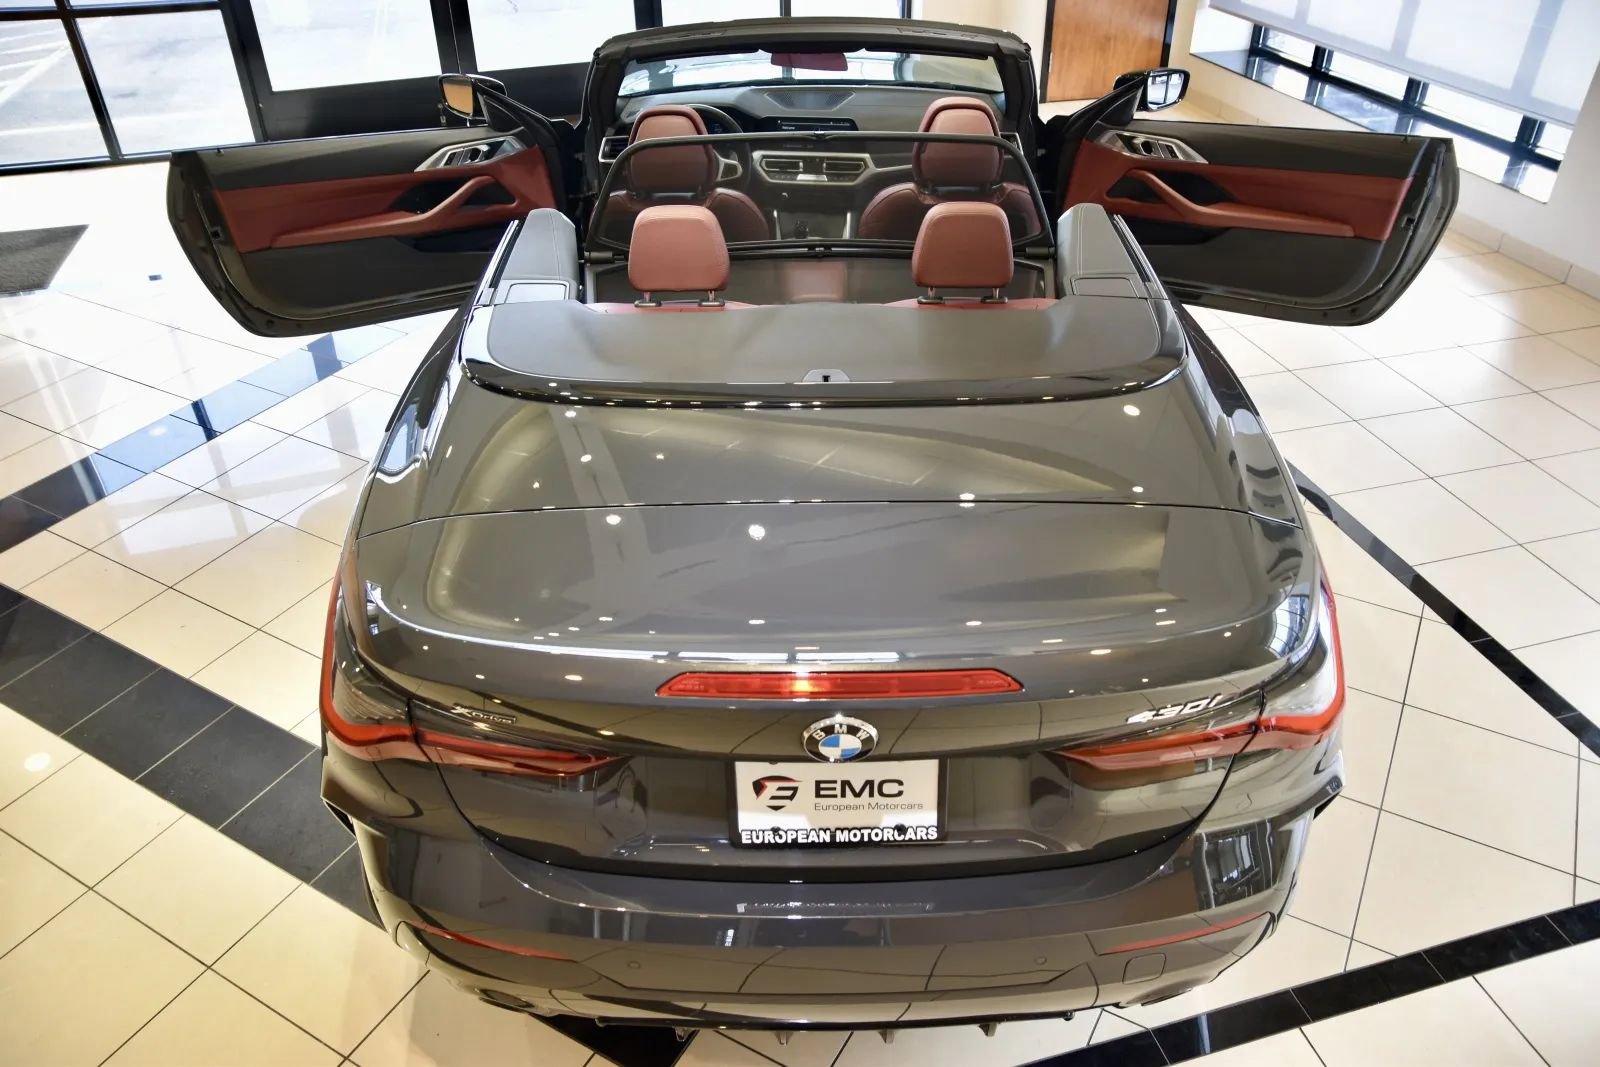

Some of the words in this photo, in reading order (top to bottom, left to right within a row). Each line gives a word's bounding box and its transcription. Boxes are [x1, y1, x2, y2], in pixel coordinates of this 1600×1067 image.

[812, 723, 870, 740] BMW
[814, 779, 904, 798] EMC
[814, 803, 865, 812] European
[868, 802, 924, 811] Motorcars
[741, 829, 831, 844] EUROPEAN
[835, 826, 938, 843] MOTORCARS
